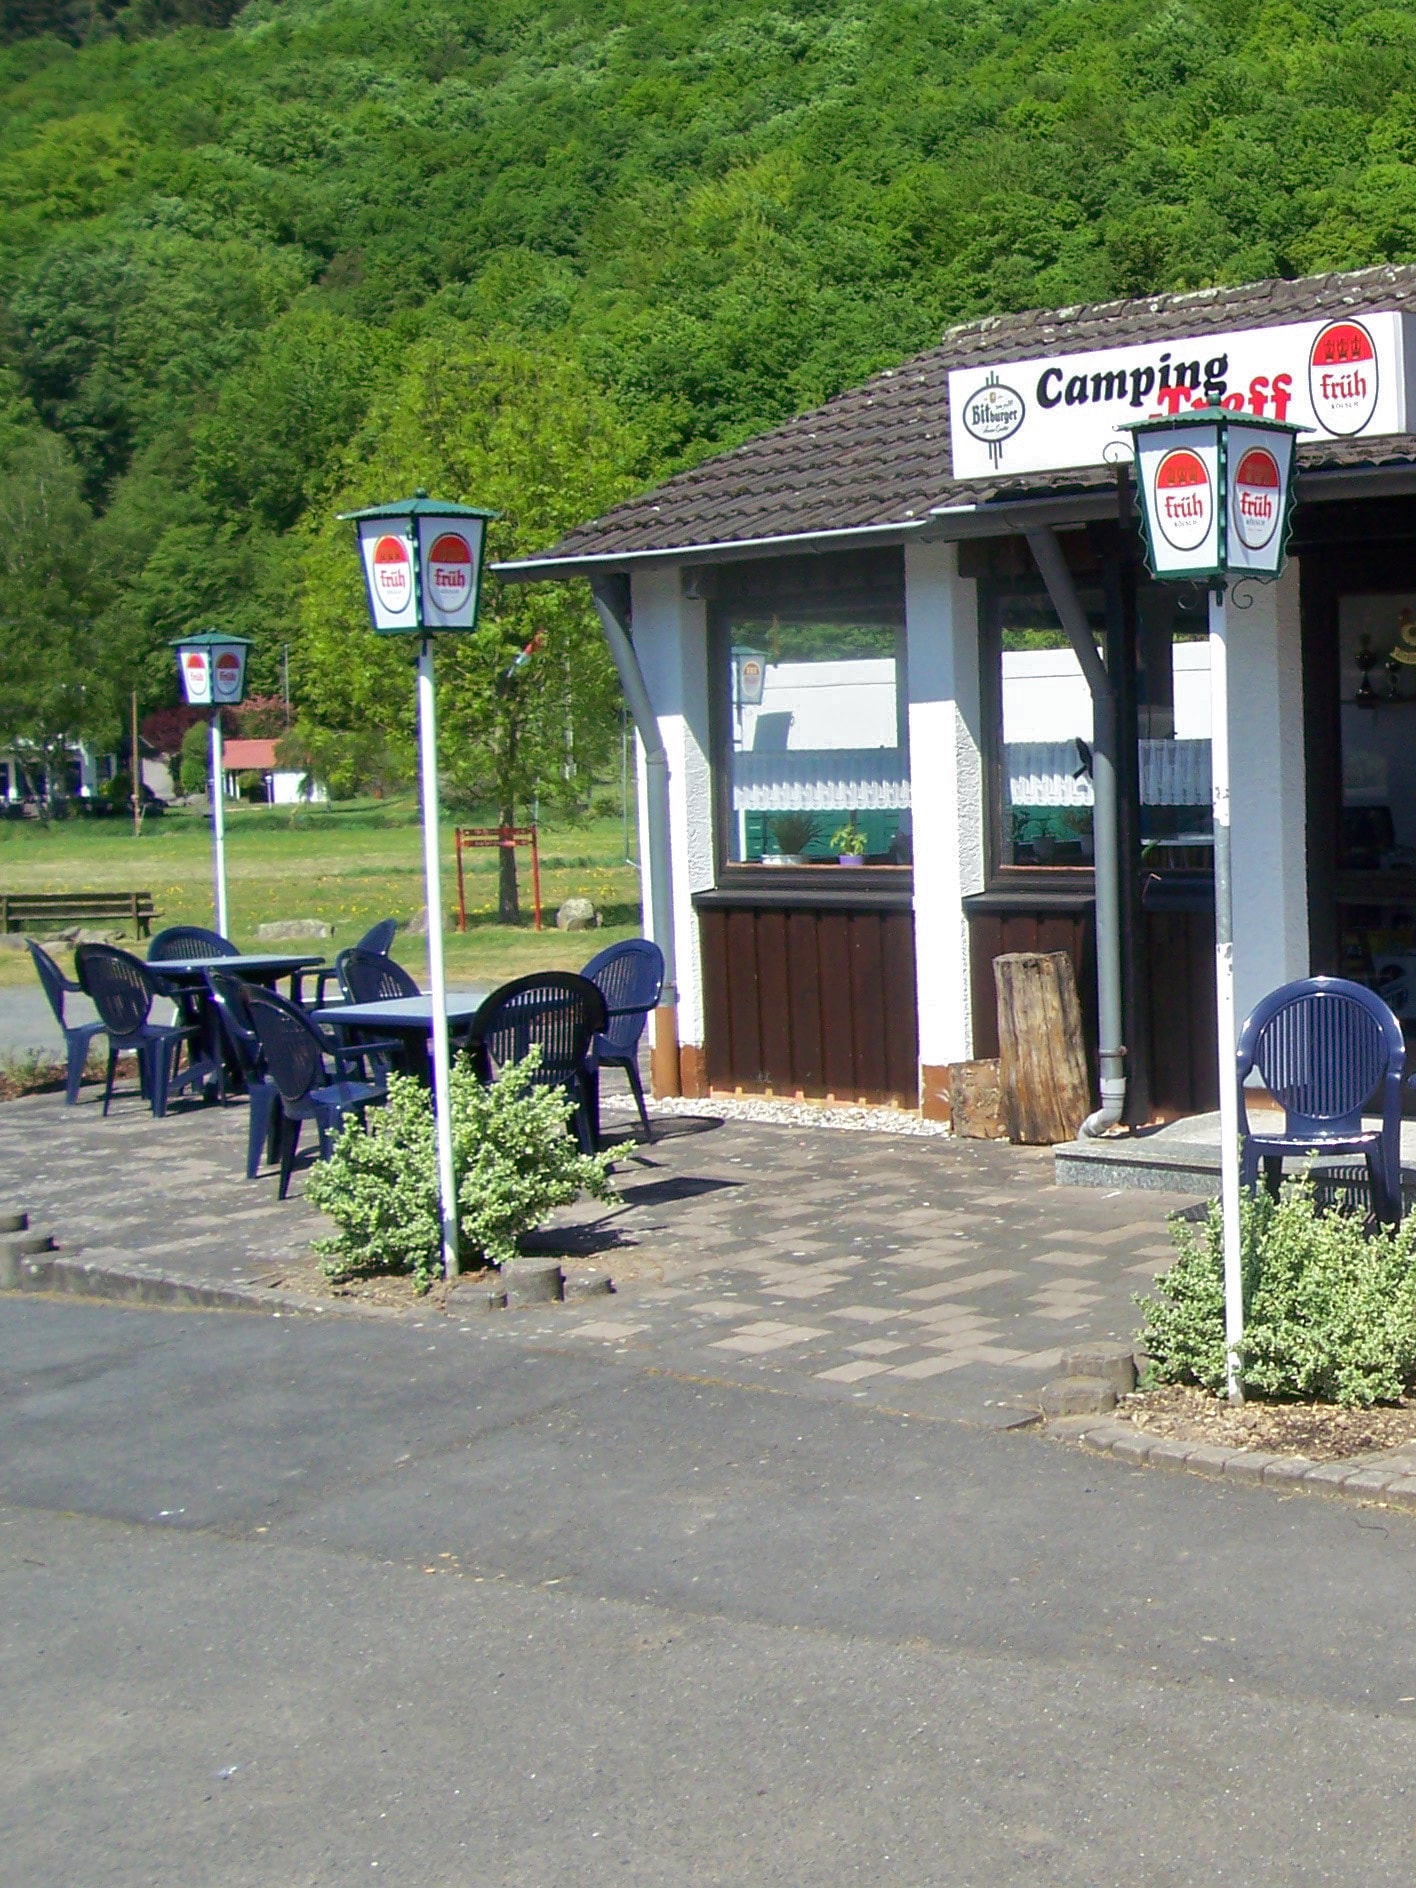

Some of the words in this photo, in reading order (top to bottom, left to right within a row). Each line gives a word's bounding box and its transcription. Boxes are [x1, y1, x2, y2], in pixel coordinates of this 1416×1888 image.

[1036, 352, 1228, 409] Camping
[1319, 369, 1367, 400] früh
[972, 403, 1018, 426] Bitburger
[1164, 492, 1203, 519] früh
[1240, 491, 1272, 519] früh
[380, 568, 406, 589] früh
[434, 568, 466, 589] früh
